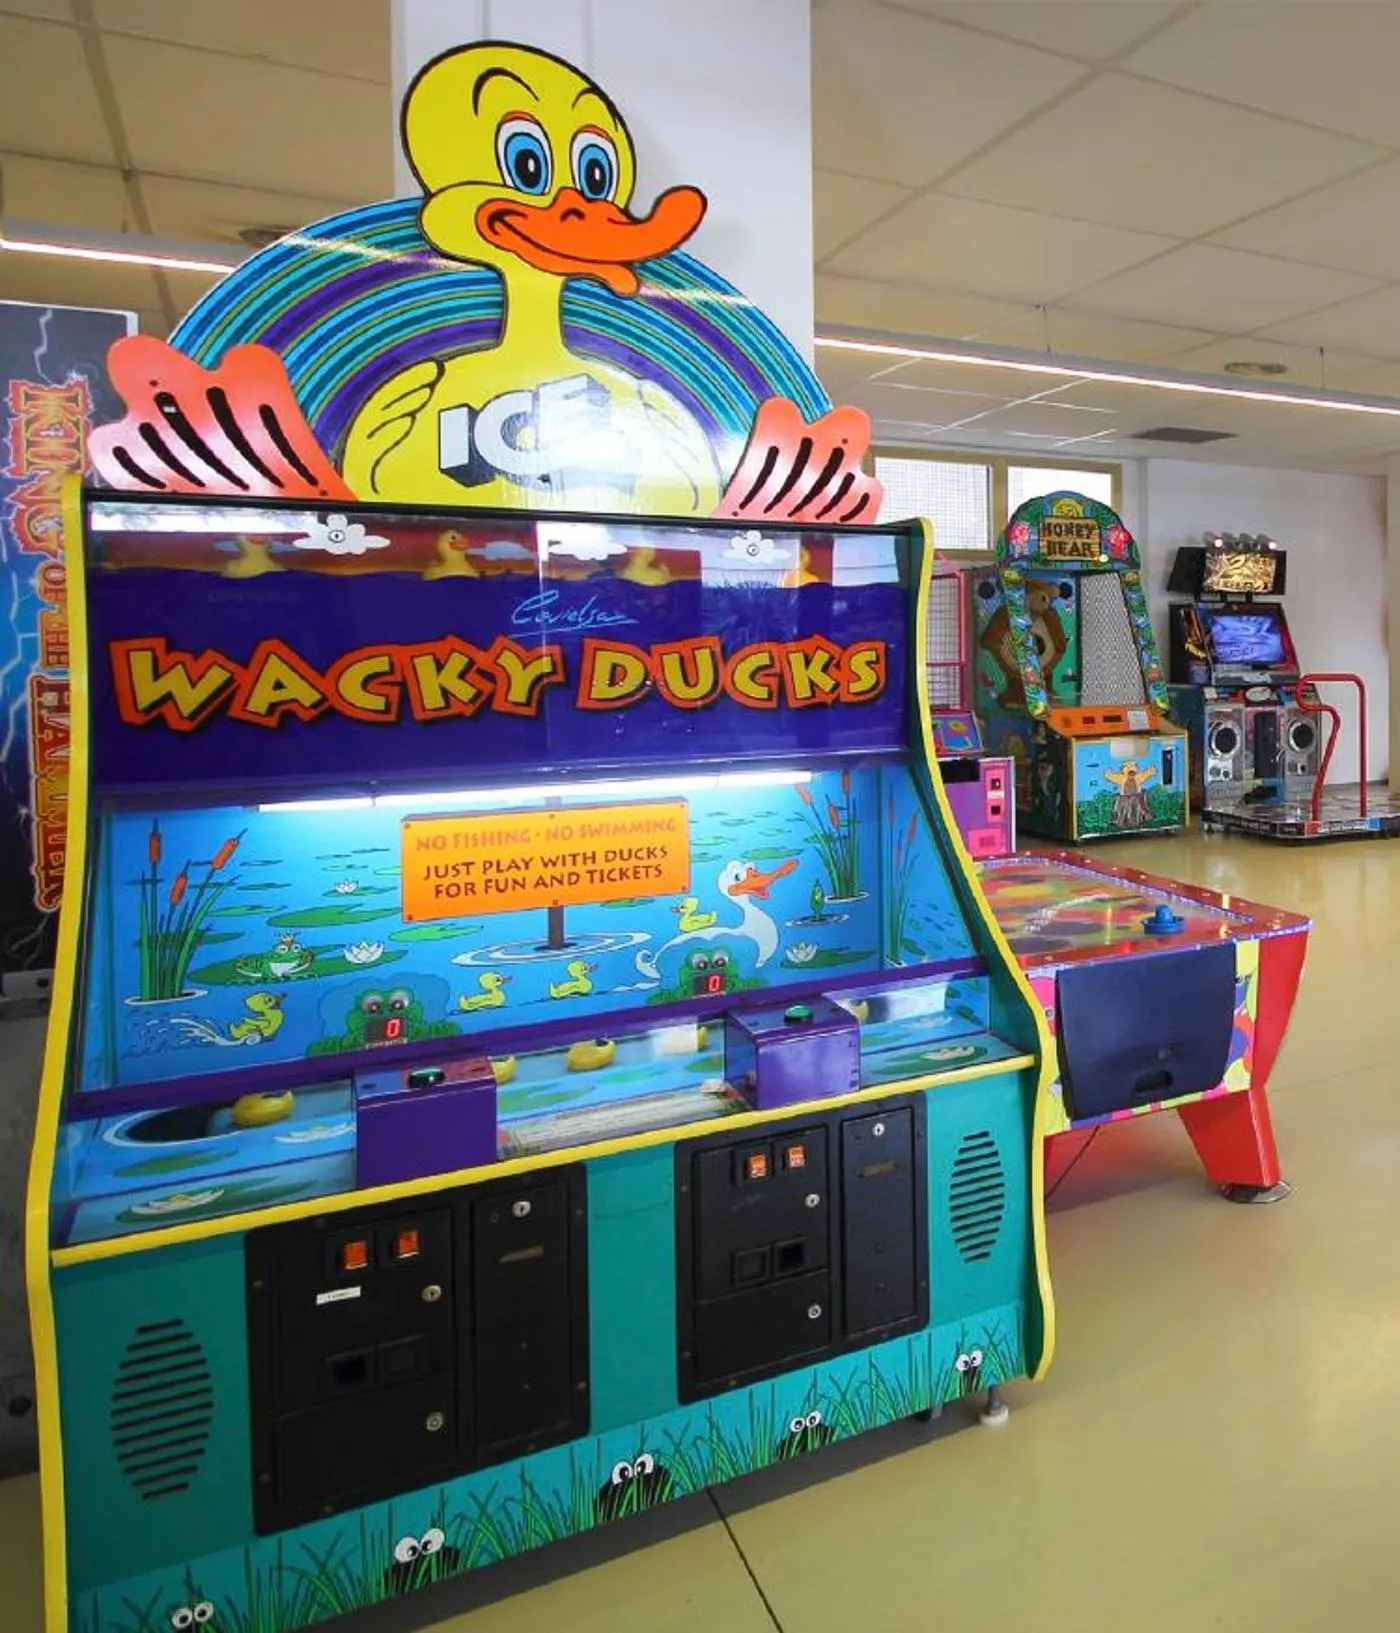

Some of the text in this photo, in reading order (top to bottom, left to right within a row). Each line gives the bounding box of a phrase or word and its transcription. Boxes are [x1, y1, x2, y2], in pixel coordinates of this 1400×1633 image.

[20, 382, 84, 552] KING
[1041, 522, 1096, 539] HONEY
[110, 635, 886, 732] WACKY DUCKS
[416, 818, 676, 852] NO FISHING NO SWIMMING
[424, 845, 668, 881] JUST PLAY WITH DUCKS
[434, 864, 662, 899] FOR FUN AND TICKETS
[708, 974, 720, 993] 0
[386, 1018, 401, 1039] 0
